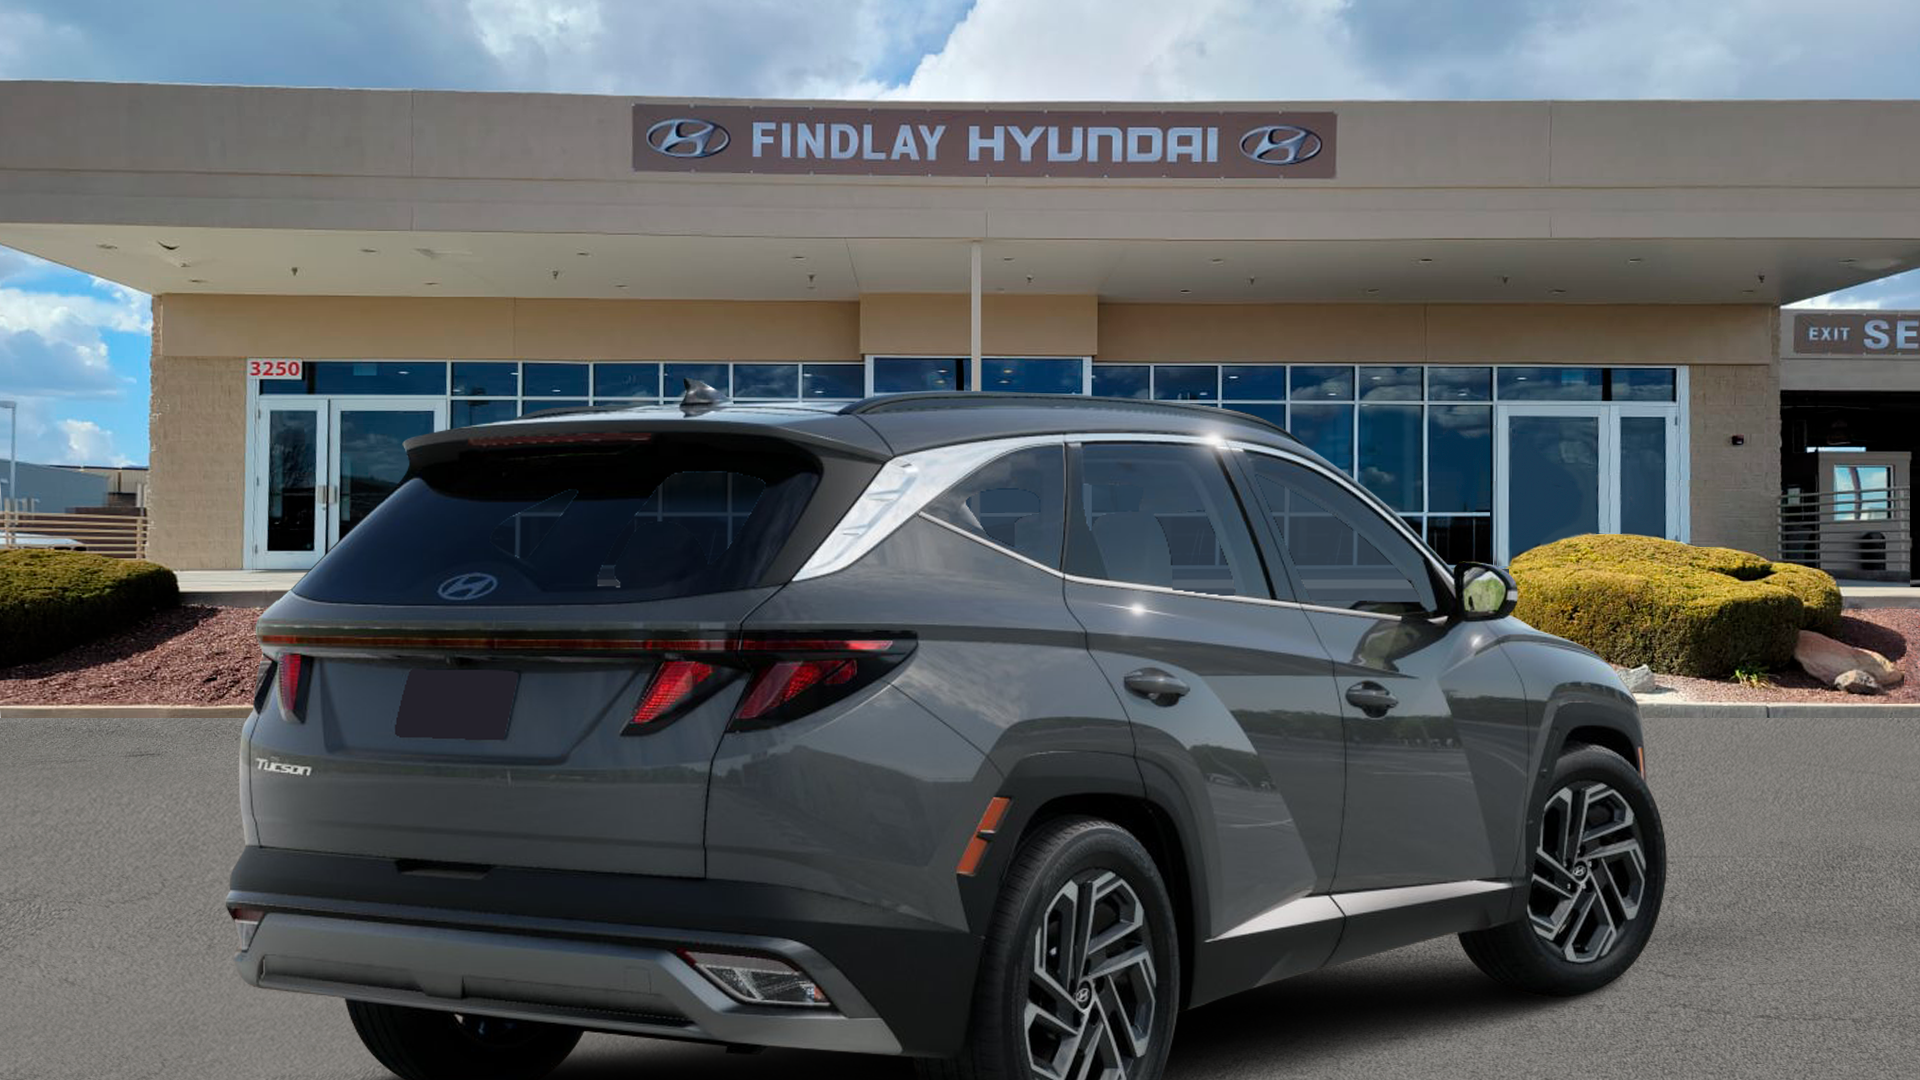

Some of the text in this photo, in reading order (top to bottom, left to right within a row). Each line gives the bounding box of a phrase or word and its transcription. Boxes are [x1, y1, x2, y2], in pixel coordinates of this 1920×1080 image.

[752, 122, 1219, 163] FINDLAY HYUNDAI
[1808, 319, 1919, 349] EXIT SE
[249, 361, 300, 376] 3250
